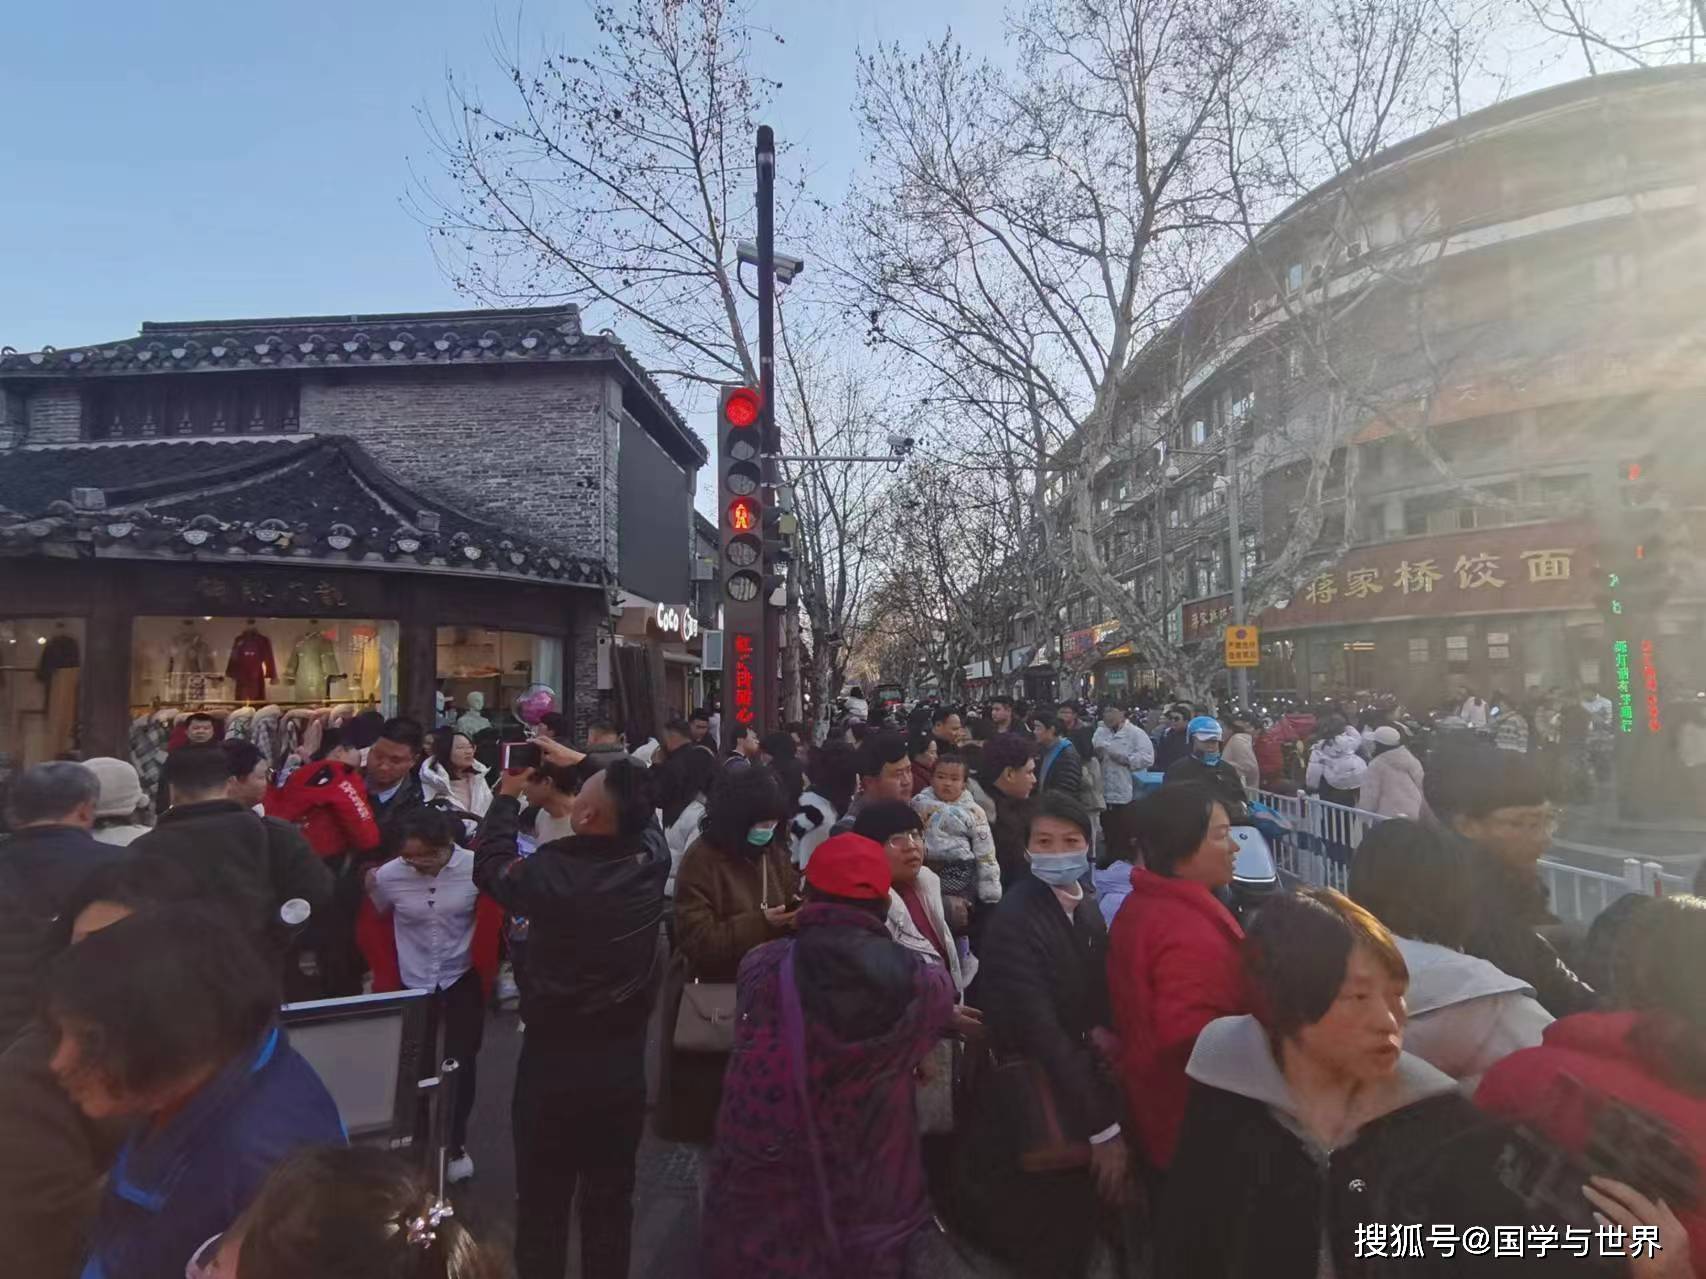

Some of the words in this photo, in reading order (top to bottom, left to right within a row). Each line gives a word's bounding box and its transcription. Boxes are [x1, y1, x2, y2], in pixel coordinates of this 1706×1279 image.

[1304, 548, 1575, 605] 蒋家桥饺面
